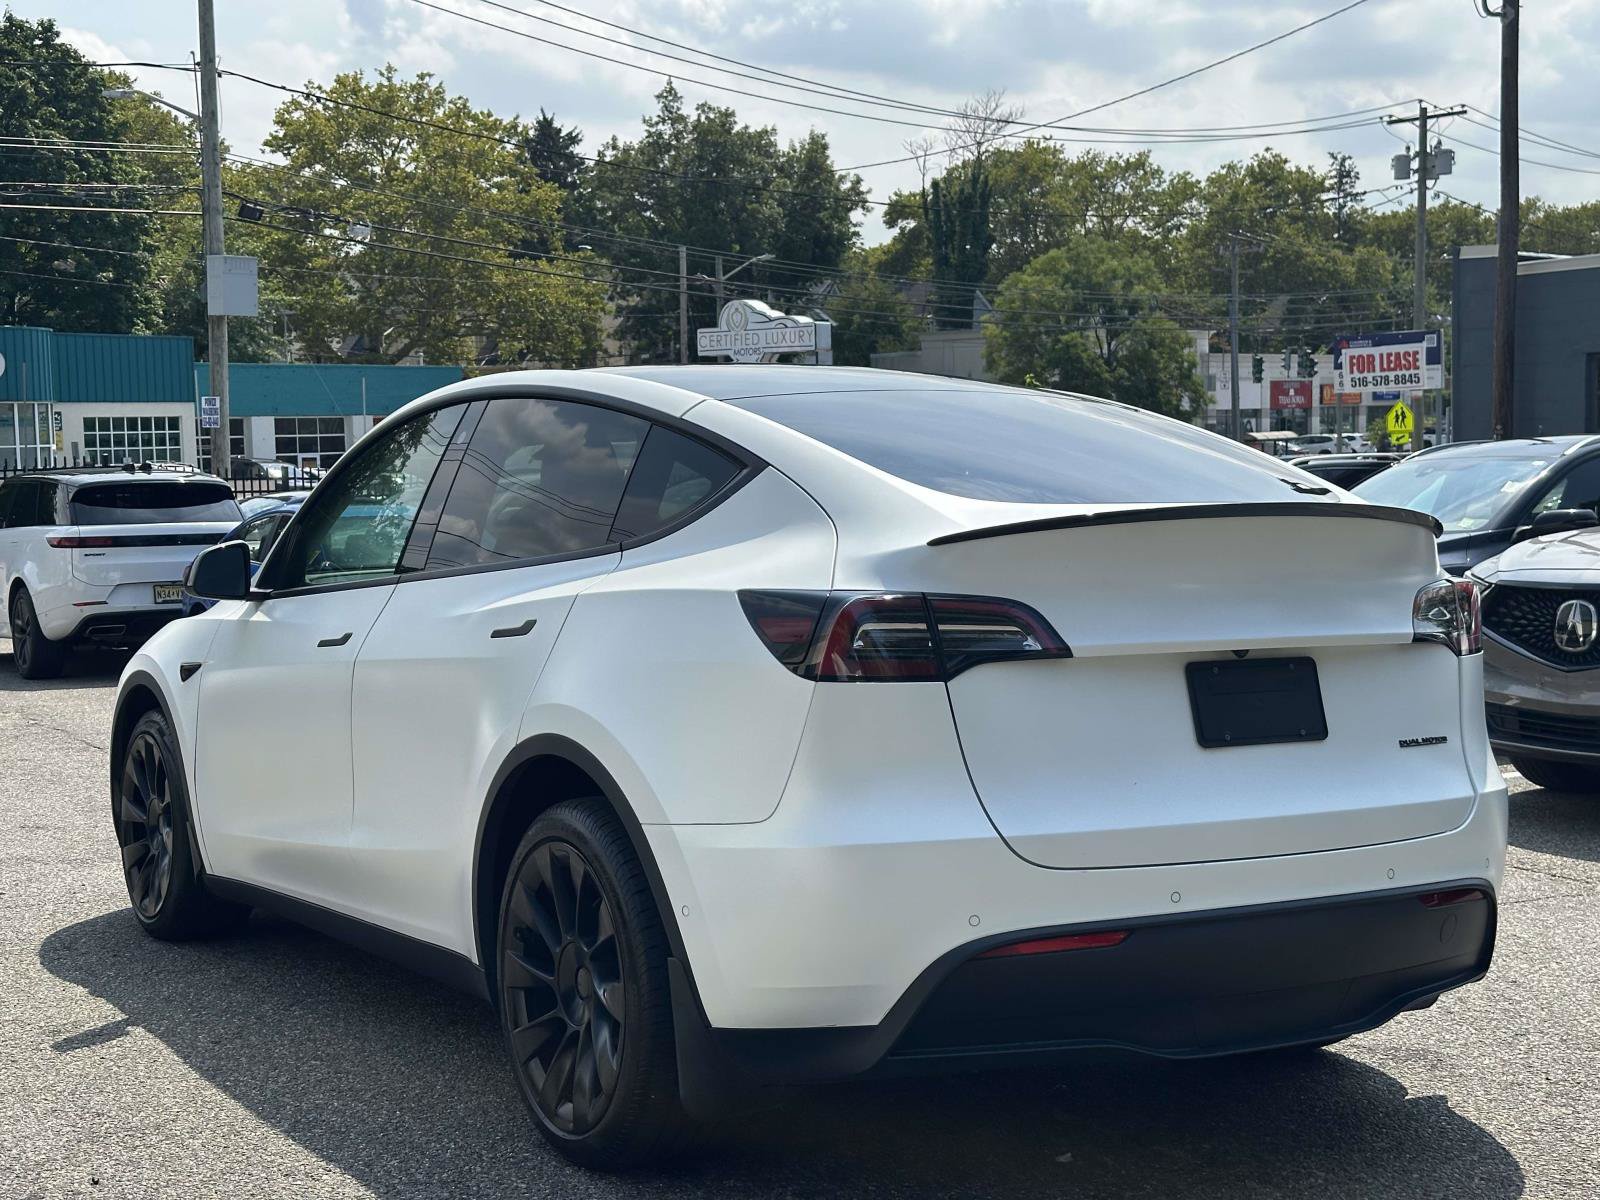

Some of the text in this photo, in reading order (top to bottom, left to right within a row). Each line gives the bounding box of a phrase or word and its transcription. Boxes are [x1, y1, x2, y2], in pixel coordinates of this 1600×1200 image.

[699, 329, 814, 349] CERTIFIED LUXURY
[733, 347, 761, 357] MOTORS
[1349, 350, 1420, 375] FOR LEASE
[1350, 373, 1421, 388] 516-578-8845
[1399, 736, 1448, 747] DUAL MOTOR
